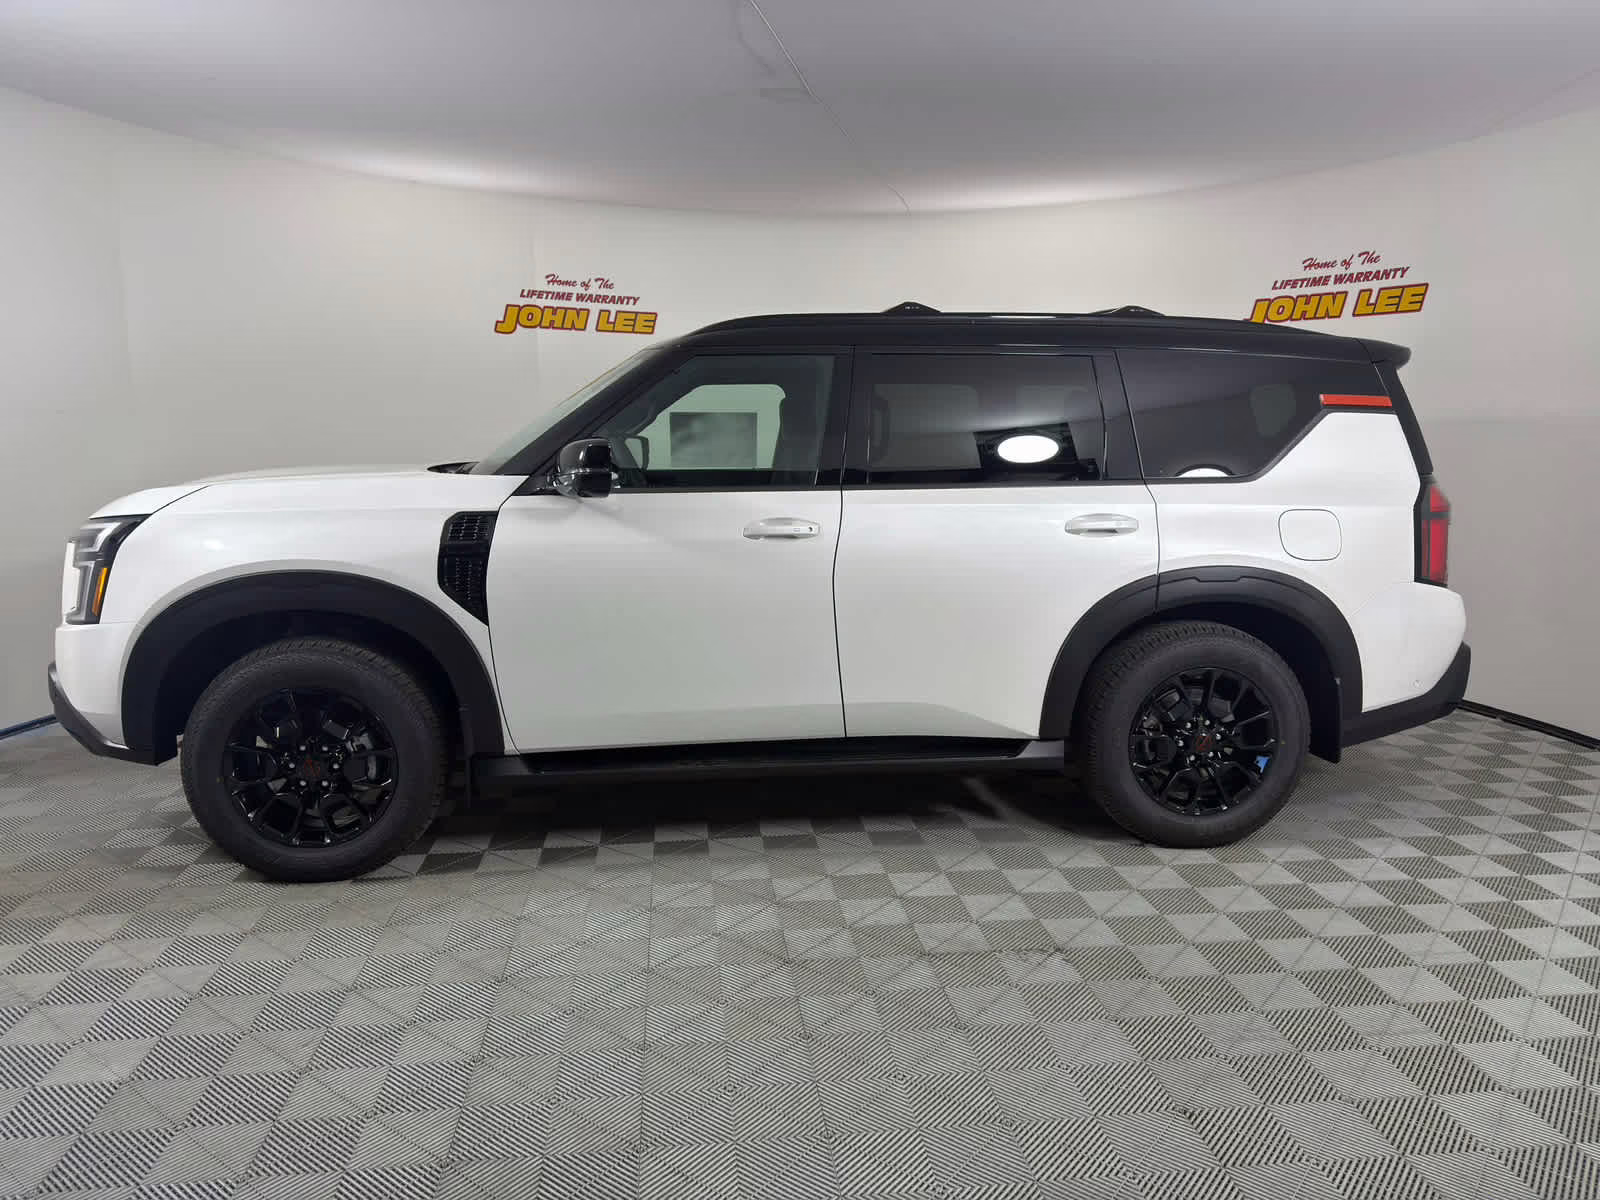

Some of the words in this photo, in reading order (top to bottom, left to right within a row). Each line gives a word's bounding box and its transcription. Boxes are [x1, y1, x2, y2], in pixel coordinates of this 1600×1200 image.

[1302, 257, 1338, 271] Home
[1341, 254, 1354, 270] of
[1358, 250, 1381, 265] The
[545, 273, 577, 287] Home
[580, 279, 592, 291] of
[594, 277, 615, 290] The
[1271, 275, 1332, 290] LIFETIME
[1333, 266, 1410, 285] WARRANTY
[519, 289, 574, 302] LIFETIME
[575, 293, 641, 306] WARRANTY
[1243, 291, 1349, 325] JOHN
[1352, 283, 1430, 317] LEE
[494, 304, 590, 335] JOHN
[595, 309, 658, 335] LEE
